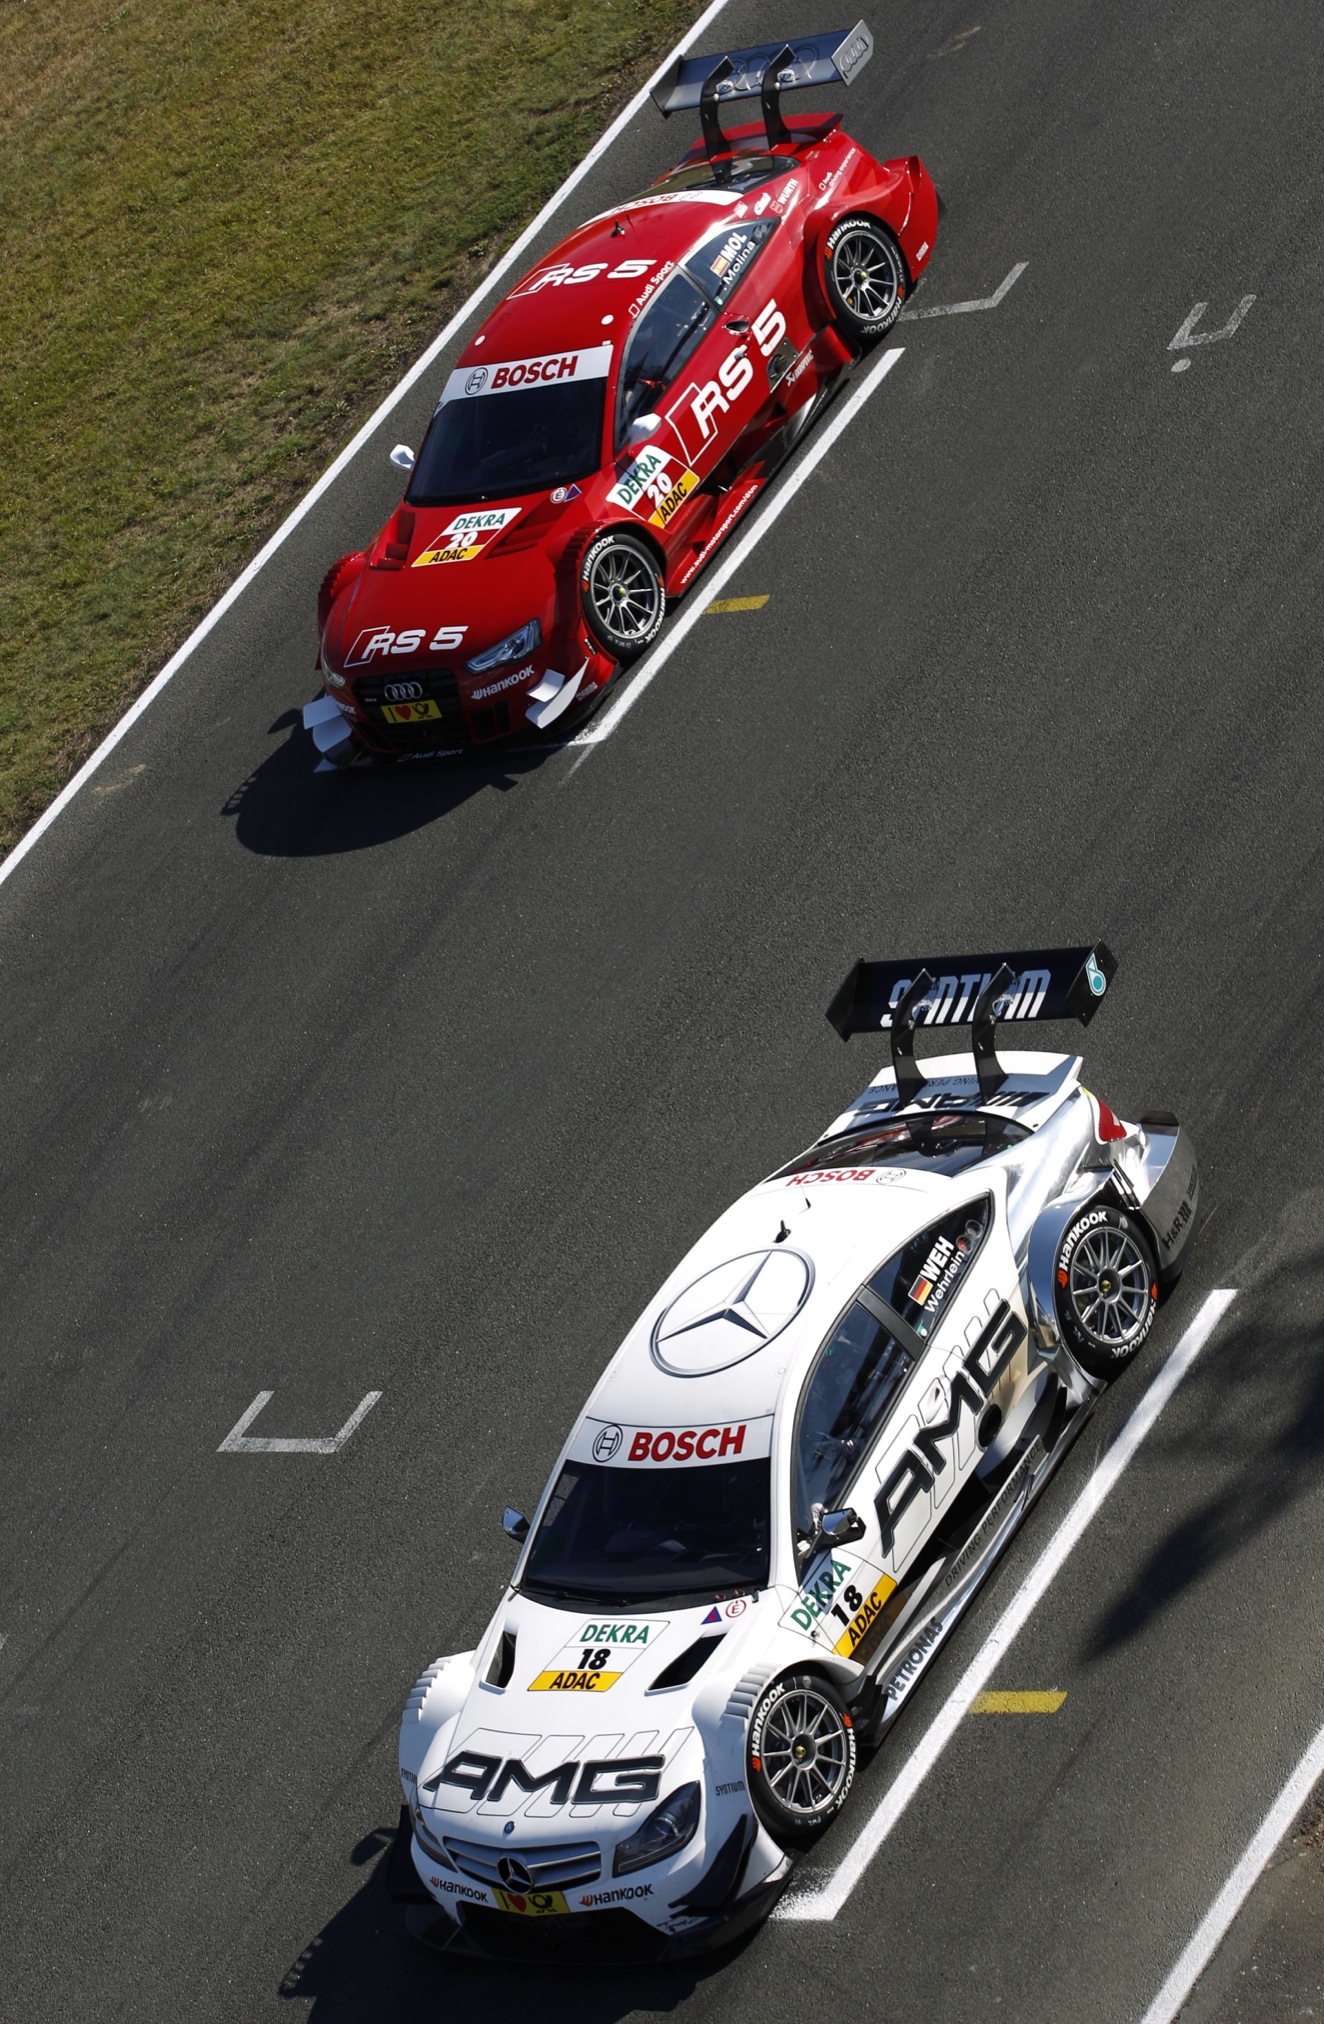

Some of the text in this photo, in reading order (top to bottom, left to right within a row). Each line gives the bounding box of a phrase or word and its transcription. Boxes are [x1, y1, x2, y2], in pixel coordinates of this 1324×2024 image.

[720, 232, 748, 262] MOL
[722, 240, 756, 284] Molina
[526, 259, 657, 292] RS 5
[636, 260, 675, 305] Audi Sport
[490, 355, 579, 390] BOSCH
[690, 298, 786, 440] RS 5
[616, 454, 662, 505] DEKRA
[647, 472, 672, 508] 20
[452, 513, 506, 531] DEKRA
[659, 482, 688, 524] ADAC
[444, 531, 479, 550] 20
[680, 484, 758, 584] www.audi-motorsport.com/dtm
[428, 548, 468, 564] ADAC
[360, 625, 470, 660] RS 5
[785, 1169, 876, 1188] BOSCH
[920, 1235, 954, 1282] WEH
[924, 1250, 966, 1313] Wehrlein
[628, 1424, 747, 1462] BOSCH
[872, 1298, 1028, 1559] AMG
[944, 1442, 1041, 1587] DRIVING PERFORMANCE
[790, 1558, 852, 1631] DEKRA
[831, 1584, 863, 1627] 18
[579, 1624, 650, 1644] DEKRA
[847, 1591, 882, 1647] ADAC
[576, 1648, 612, 1670] 18
[885, 1616, 944, 1702] PETRONAS
[548, 1672, 600, 1690] ADAC
[422, 1750, 666, 1805] AMG
